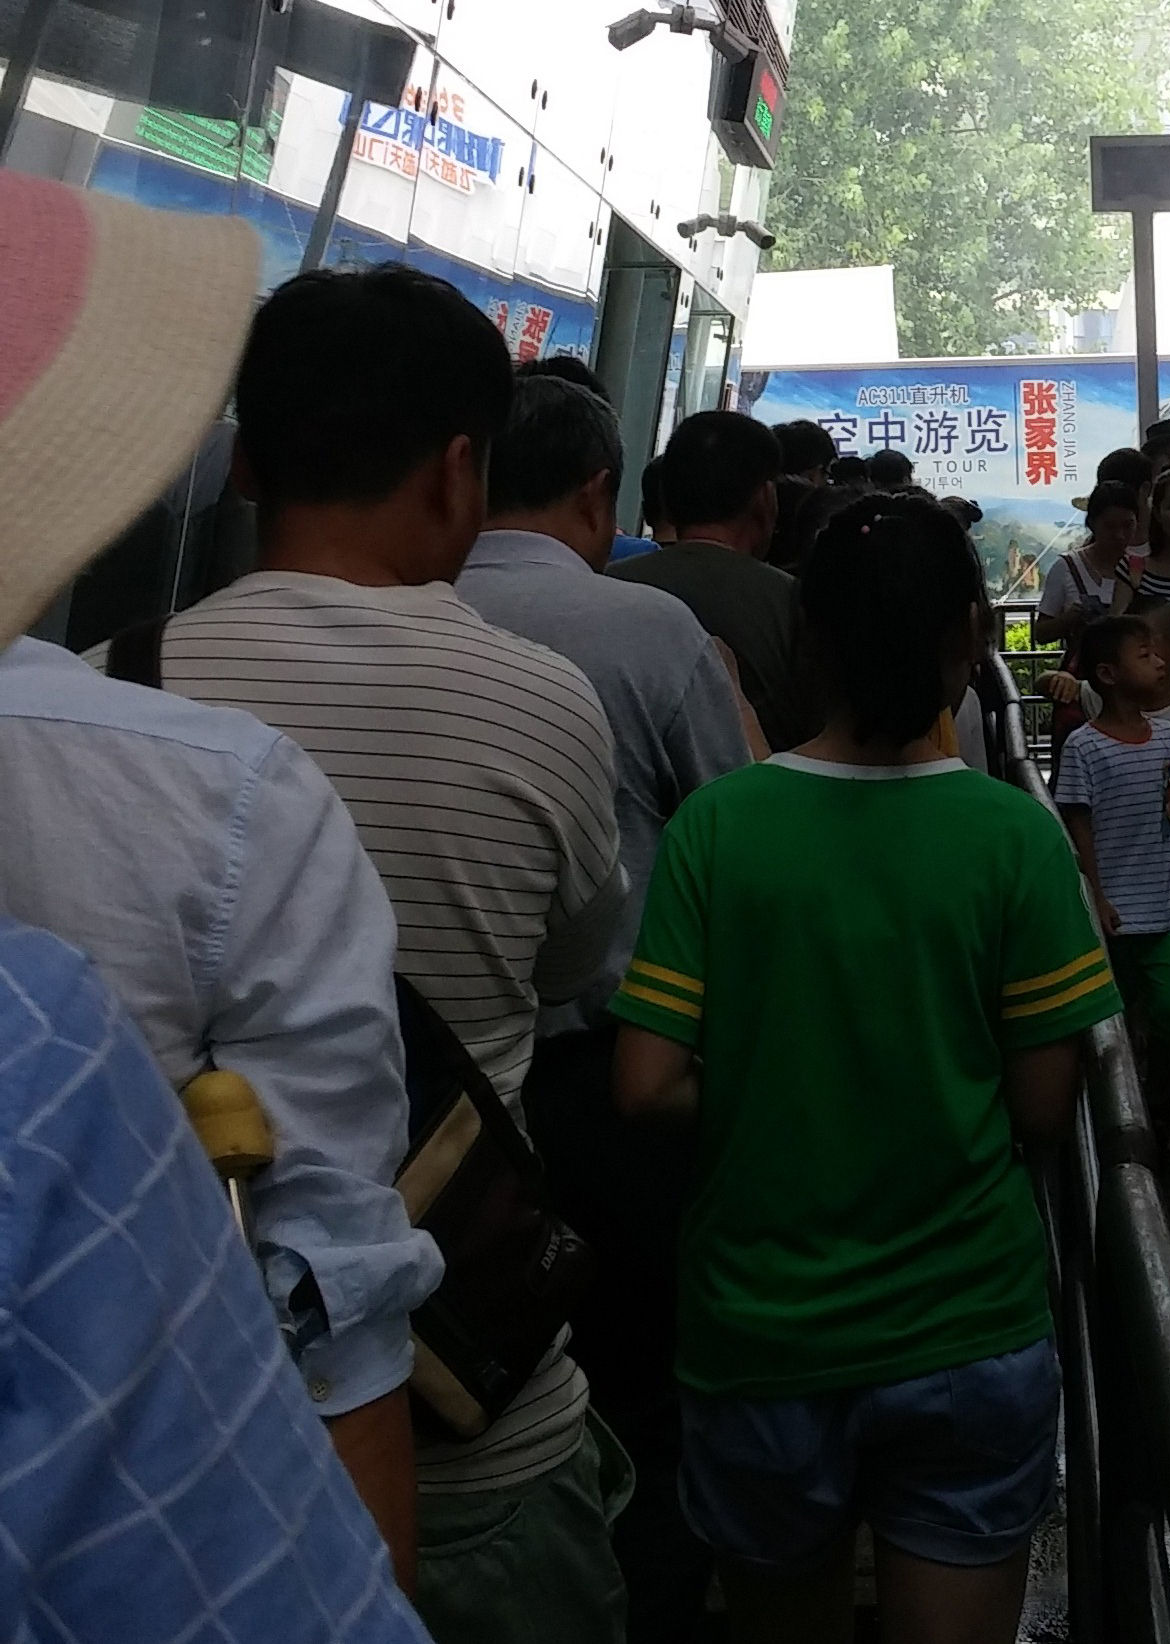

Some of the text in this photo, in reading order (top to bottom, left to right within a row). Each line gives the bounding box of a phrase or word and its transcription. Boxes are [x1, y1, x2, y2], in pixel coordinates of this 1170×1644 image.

[817, 409, 1009, 457] 空中游览
[933, 460, 988, 473] TOUR
[1023, 382, 1058, 486] 张家界
[1061, 381, 1077, 482] ZHANG JIA JIE
